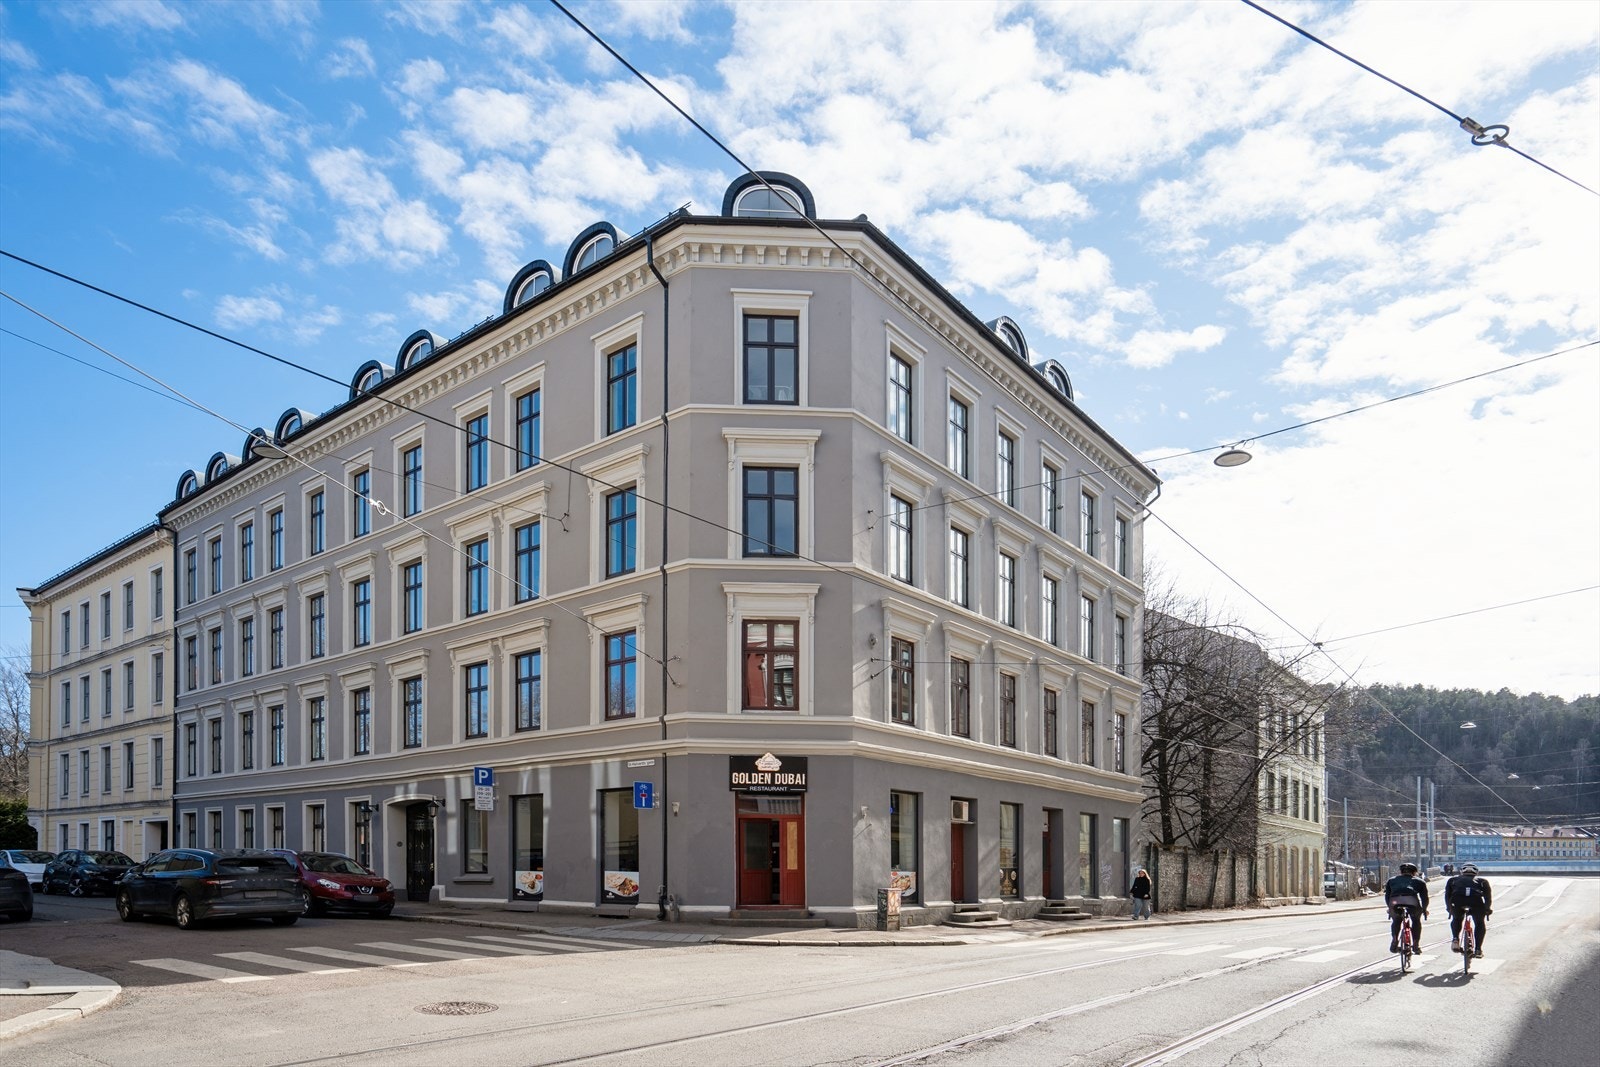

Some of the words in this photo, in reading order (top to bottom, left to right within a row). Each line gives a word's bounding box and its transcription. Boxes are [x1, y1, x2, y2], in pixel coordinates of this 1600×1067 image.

[478, 769, 489, 784] P
[732, 772, 771, 785] GOLDEN
[774, 773, 806, 785] DUBAI
